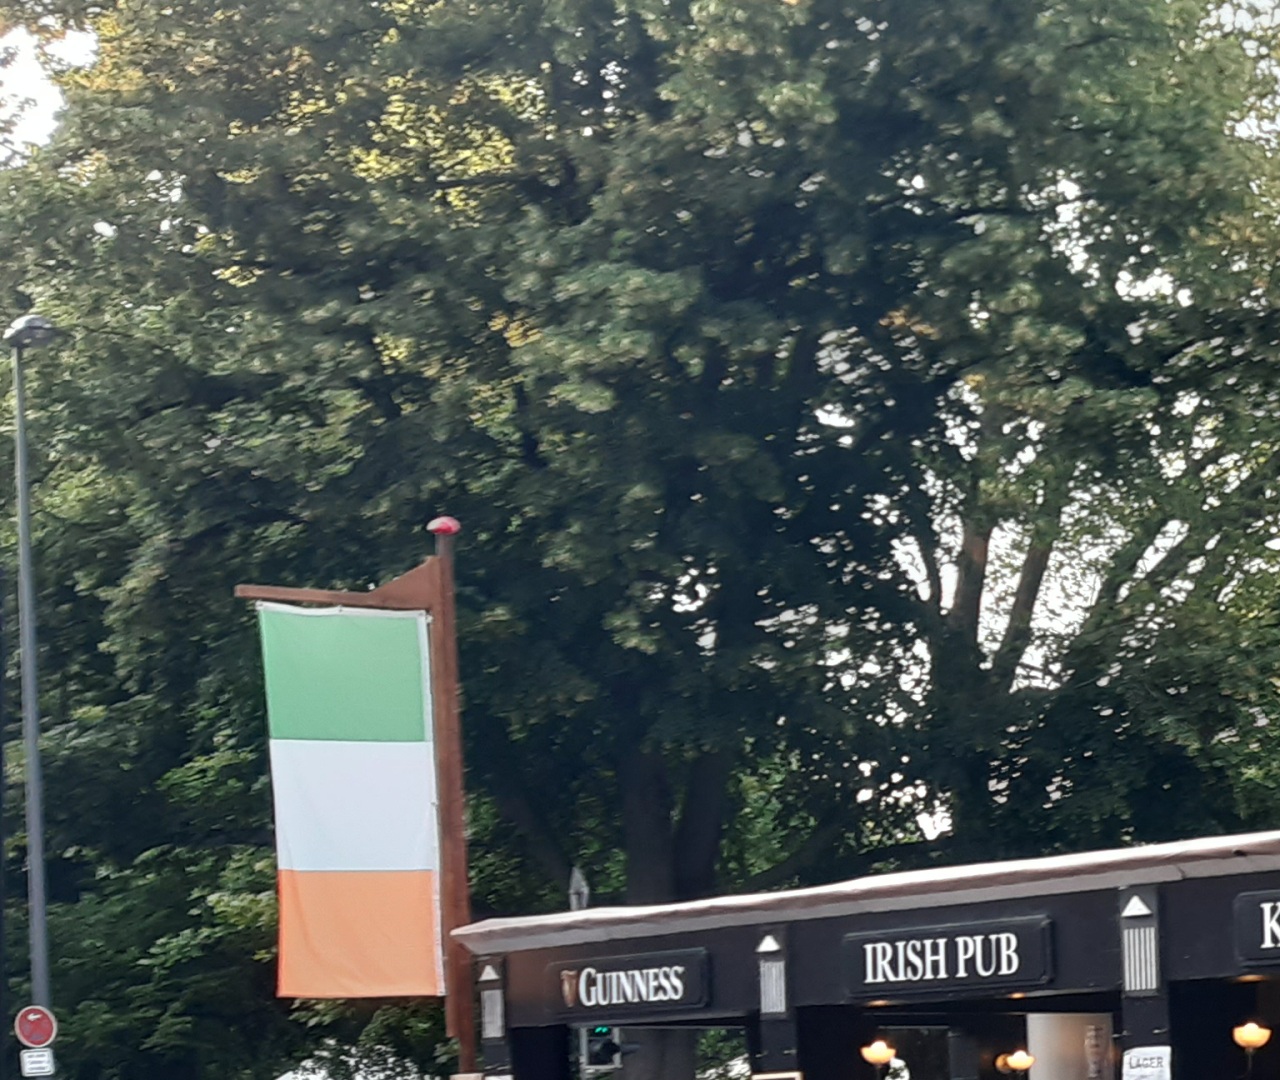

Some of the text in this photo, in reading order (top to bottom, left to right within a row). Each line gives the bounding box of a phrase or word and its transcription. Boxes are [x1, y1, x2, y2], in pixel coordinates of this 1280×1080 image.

[863, 932, 1019, 984] IRISH PUB
[579, 966, 685, 1006] GUINNESS
